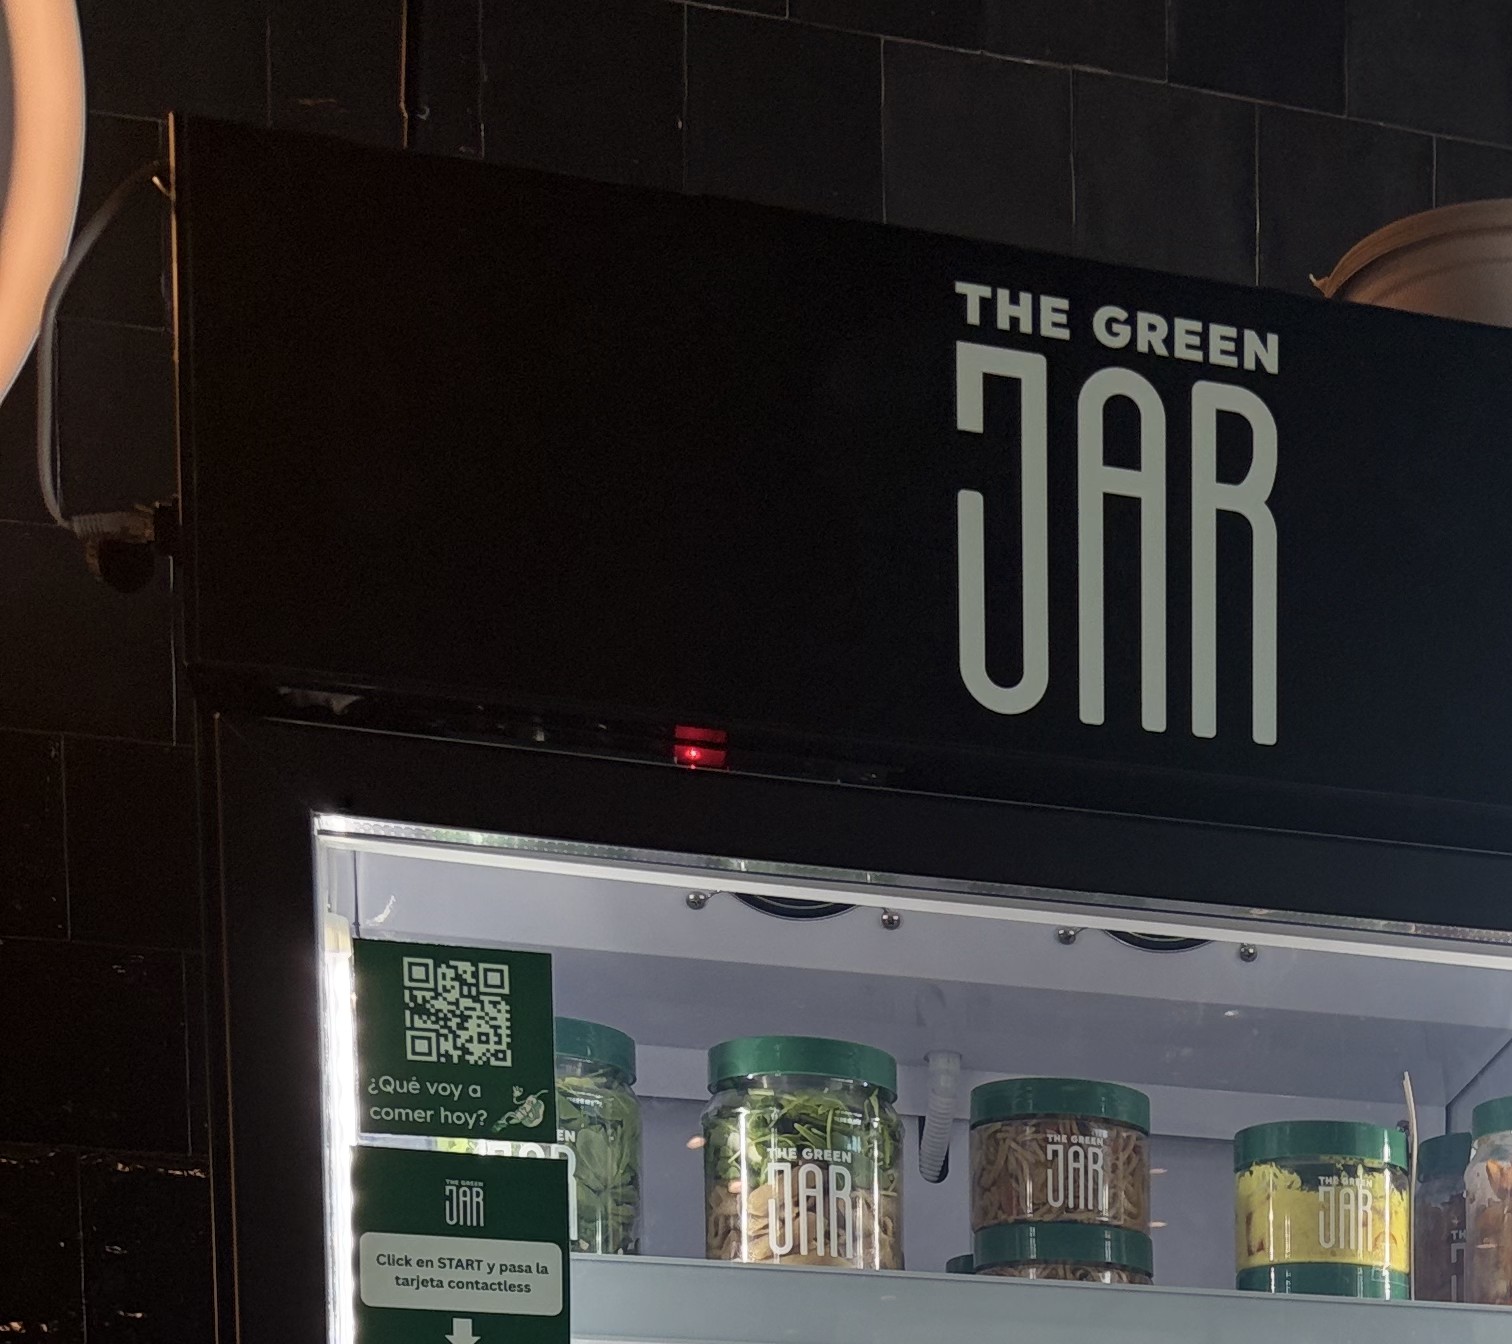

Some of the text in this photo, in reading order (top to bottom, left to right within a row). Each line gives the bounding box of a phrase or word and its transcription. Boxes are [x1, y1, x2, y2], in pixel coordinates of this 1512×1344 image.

[955, 281, 1279, 374] THE GREEN
[956, 340, 1277, 745] JAR
[367, 1076, 481, 1100] ¿Qué voy a
[370, 1106, 487, 1129] comer hoy?
[767, 1147, 851, 1164] THE GREEN
[1047, 1134, 1104, 1146] THE GREEN
[1047, 1144, 1104, 1211] JAR
[445, 1185, 484, 1227] JAR
[768, 1162, 852, 1259] JAR
[1319, 1186, 1373, 1252] JAR
[376, 1253, 549, 1275] Click en START y pasa la
[395, 1275, 531, 1293] tarjeta contactless
